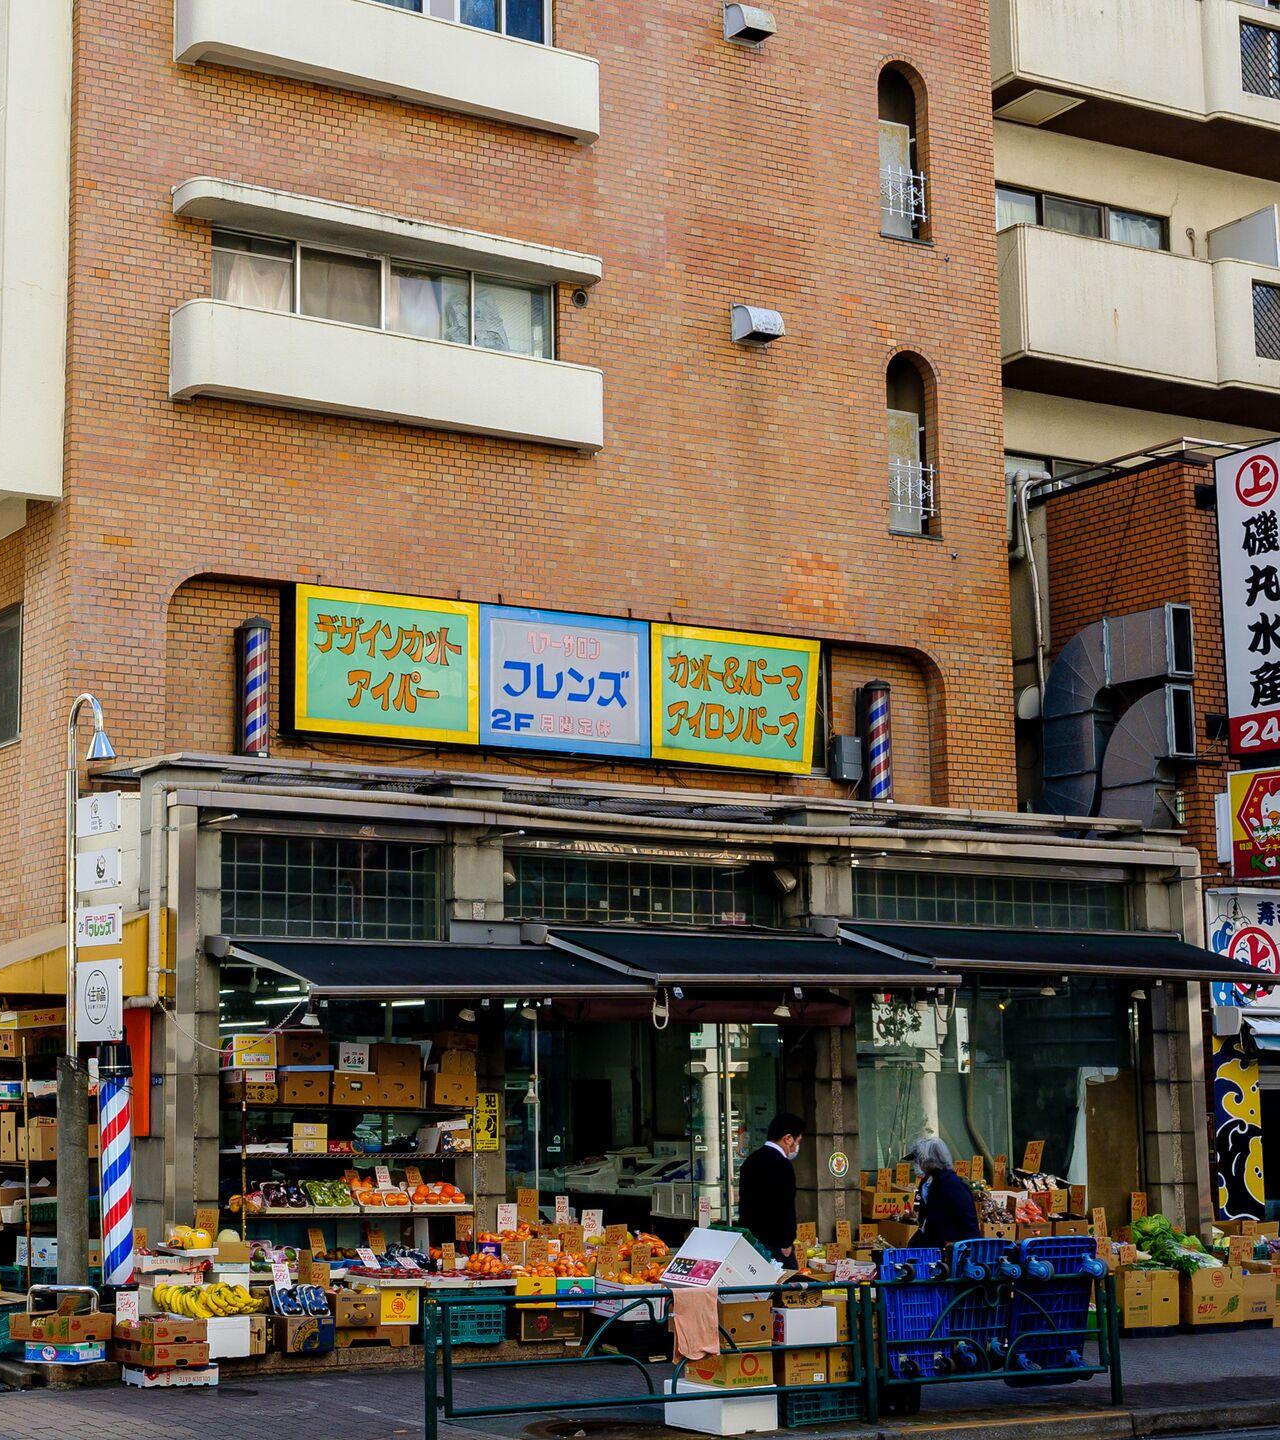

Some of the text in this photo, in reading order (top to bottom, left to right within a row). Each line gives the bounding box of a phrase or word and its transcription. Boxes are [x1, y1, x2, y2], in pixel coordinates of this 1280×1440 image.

[314, 613, 462, 666] デザインカット
[527, 631, 602, 660] ヘアーサロン
[348, 670, 440, 713] アイパー
[502, 659, 632, 709] フレンズ
[668, 650, 804, 701] カット&パーマ
[491, 708, 612, 738] 2F 月曜定休
[667, 700, 798, 749] アイロンパーマ
[88, 921, 112, 937] フレンズ
[875, 1203, 901, 1213] にんじん
